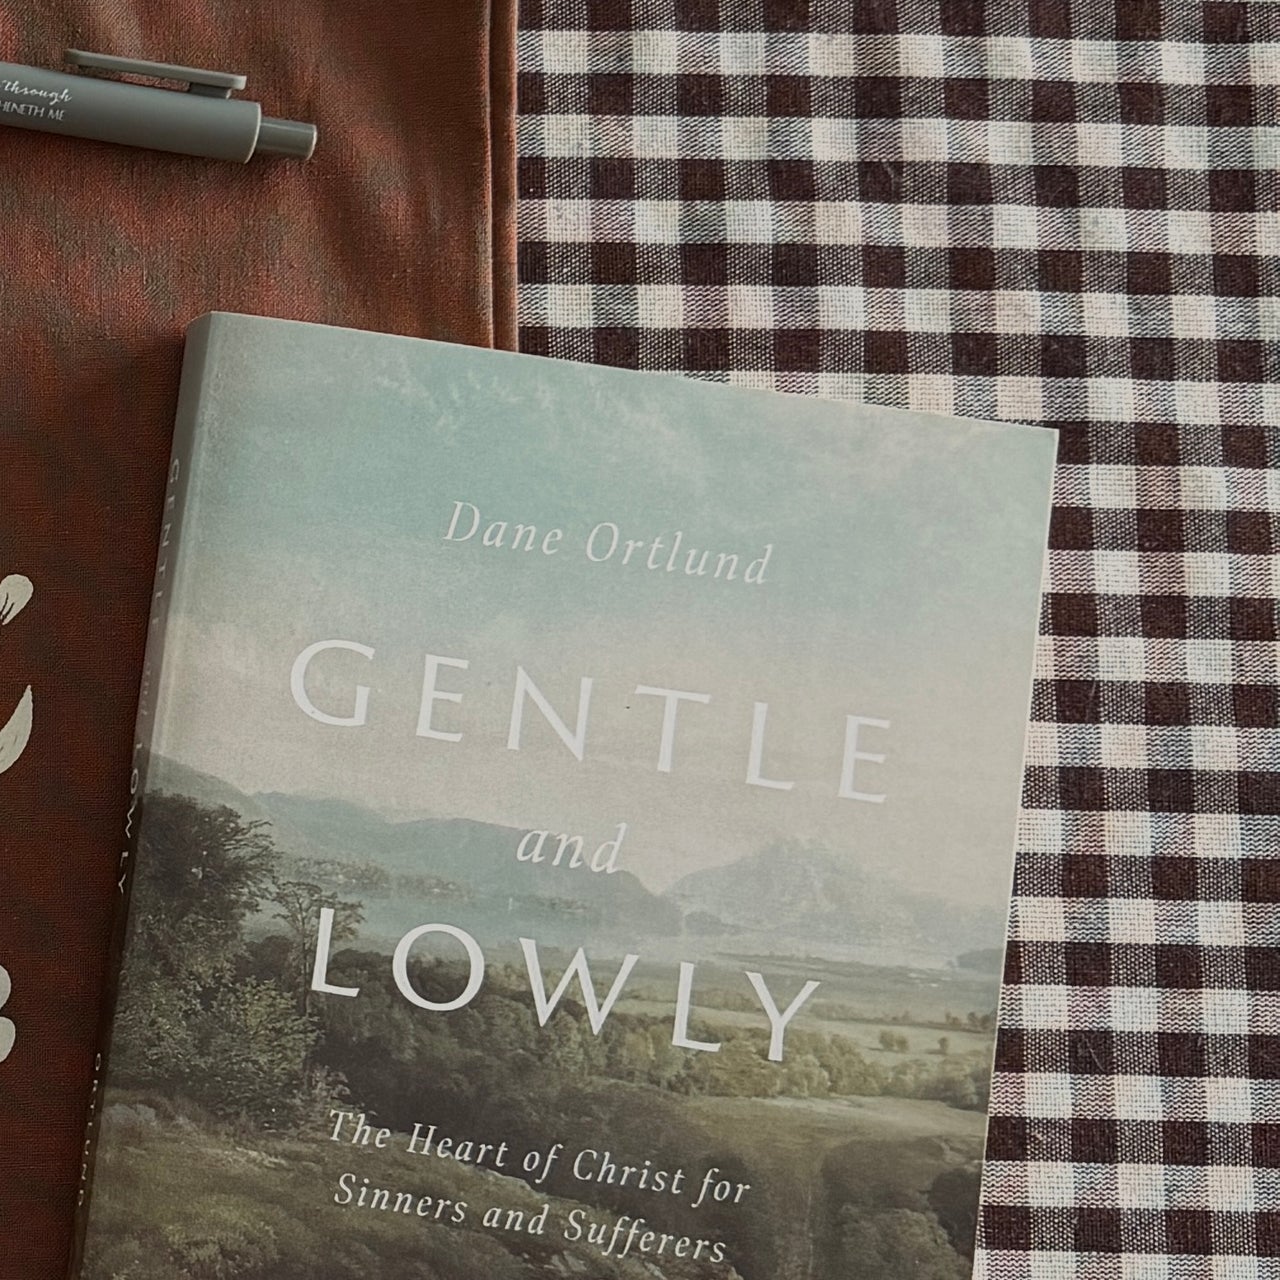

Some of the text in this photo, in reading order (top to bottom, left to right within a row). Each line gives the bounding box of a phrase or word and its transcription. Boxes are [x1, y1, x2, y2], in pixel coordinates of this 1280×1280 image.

[0, 79, 72, 106] through
[46, 109, 65, 121] ME
[444, 500, 774, 587] Dane Ortlund
[289, 639, 891, 804] GENTLE
[516, 821, 629, 875] and
[311, 907, 821, 1062] LOWLY
[329, 1109, 752, 1210] The Heart of Christ for
[334, 1172, 727, 1265] Sinners and Sufferers
